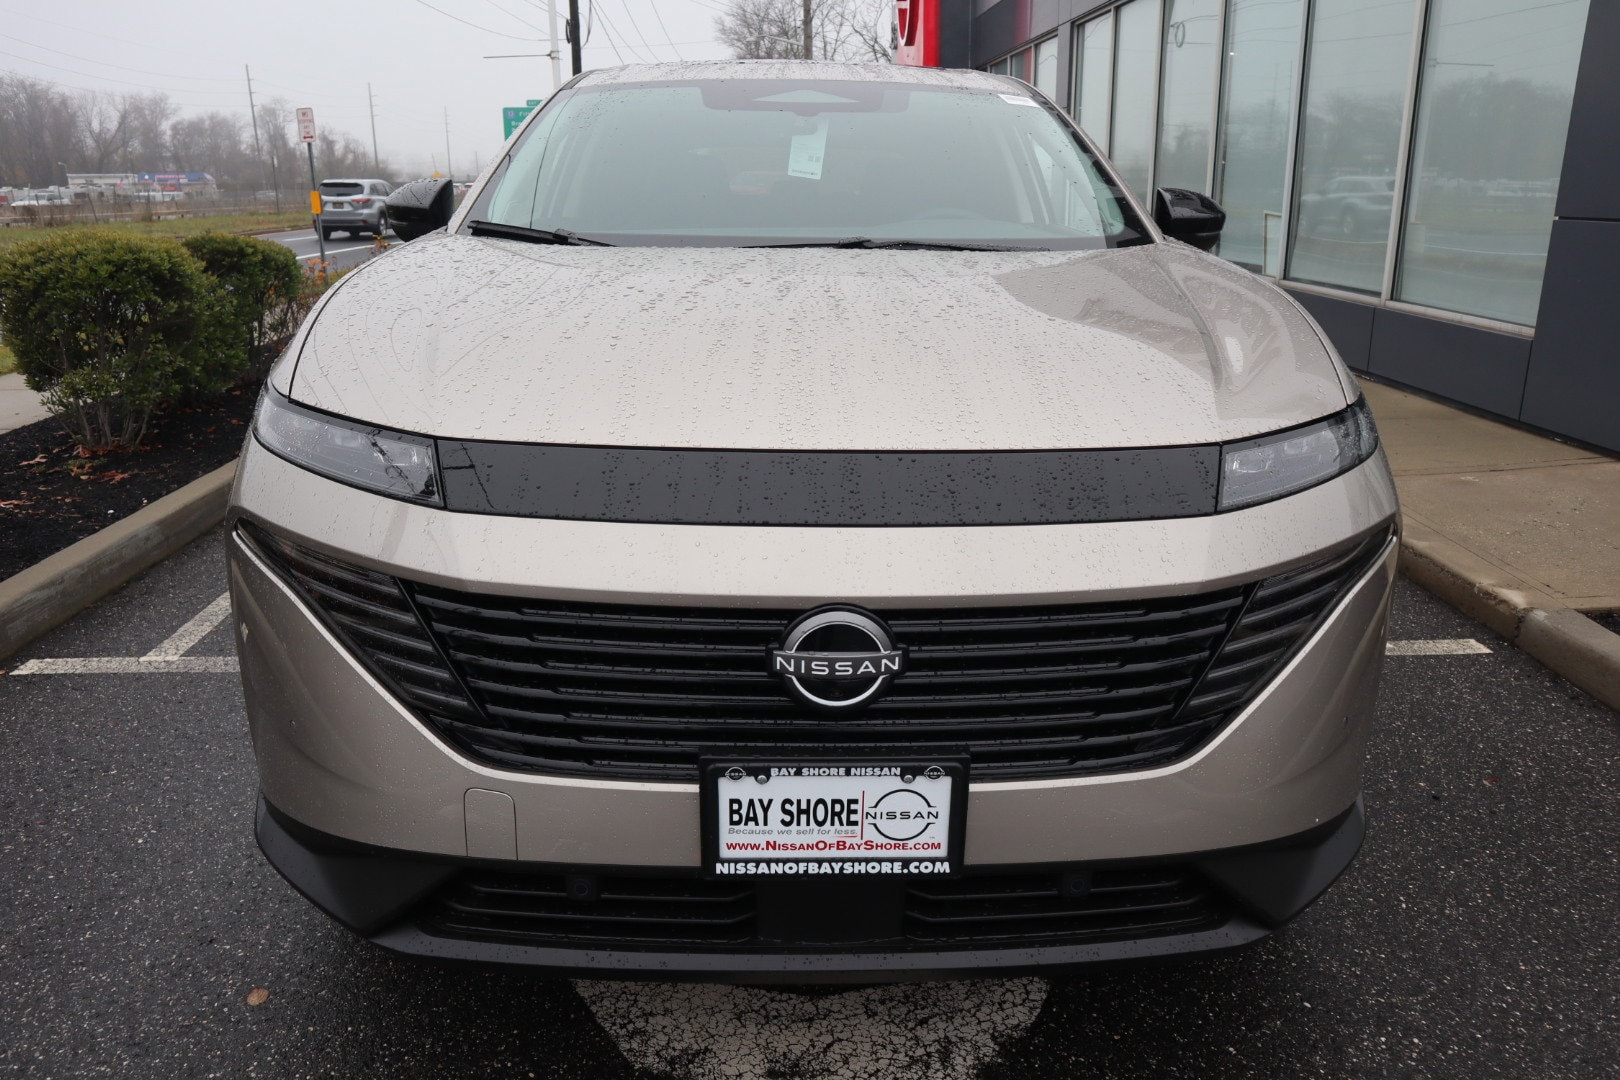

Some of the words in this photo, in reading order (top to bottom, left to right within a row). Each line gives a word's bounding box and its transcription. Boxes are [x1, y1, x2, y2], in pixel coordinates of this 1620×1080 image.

[776, 656, 899, 676] NISSAN
[770, 767, 796, 776] BAY
[801, 767, 846, 776] SHORE
[850, 766, 901, 776] NISSAN
[728, 798, 773, 827] BAY
[780, 798, 859, 827] SHORE
[865, 811, 939, 820] NISSAN
[728, 827, 774, 835] Because
[715, 861, 951, 875] NISSANOFBAYSHORE.COM
